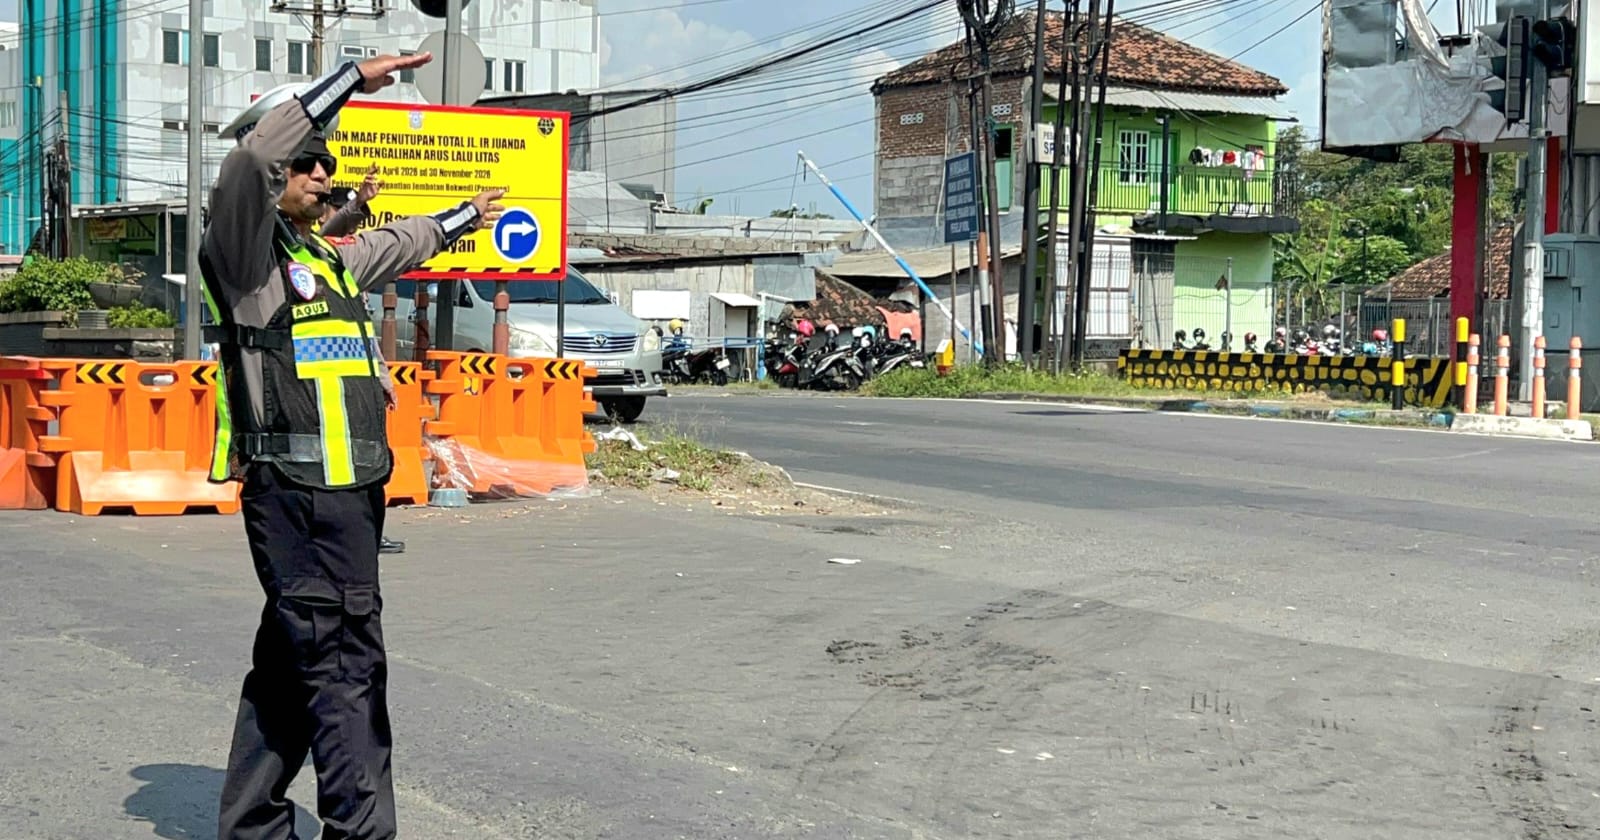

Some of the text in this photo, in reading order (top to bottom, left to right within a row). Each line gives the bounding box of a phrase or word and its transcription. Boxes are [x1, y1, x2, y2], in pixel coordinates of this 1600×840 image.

[351, 131, 378, 144] MAAF
[380, 132, 435, 146] PENUTUPAN
[437, 135, 464, 148] TOTAL
[467, 137, 478, 148] JL.
[480, 137, 489, 149] IR
[492, 138, 526, 150] JUANDA
[340, 145, 500, 163] DAN PENGALIHAN ARUS LALU LITAS
[382, 165, 399, 177] April
[439, 168, 472, 178] November
